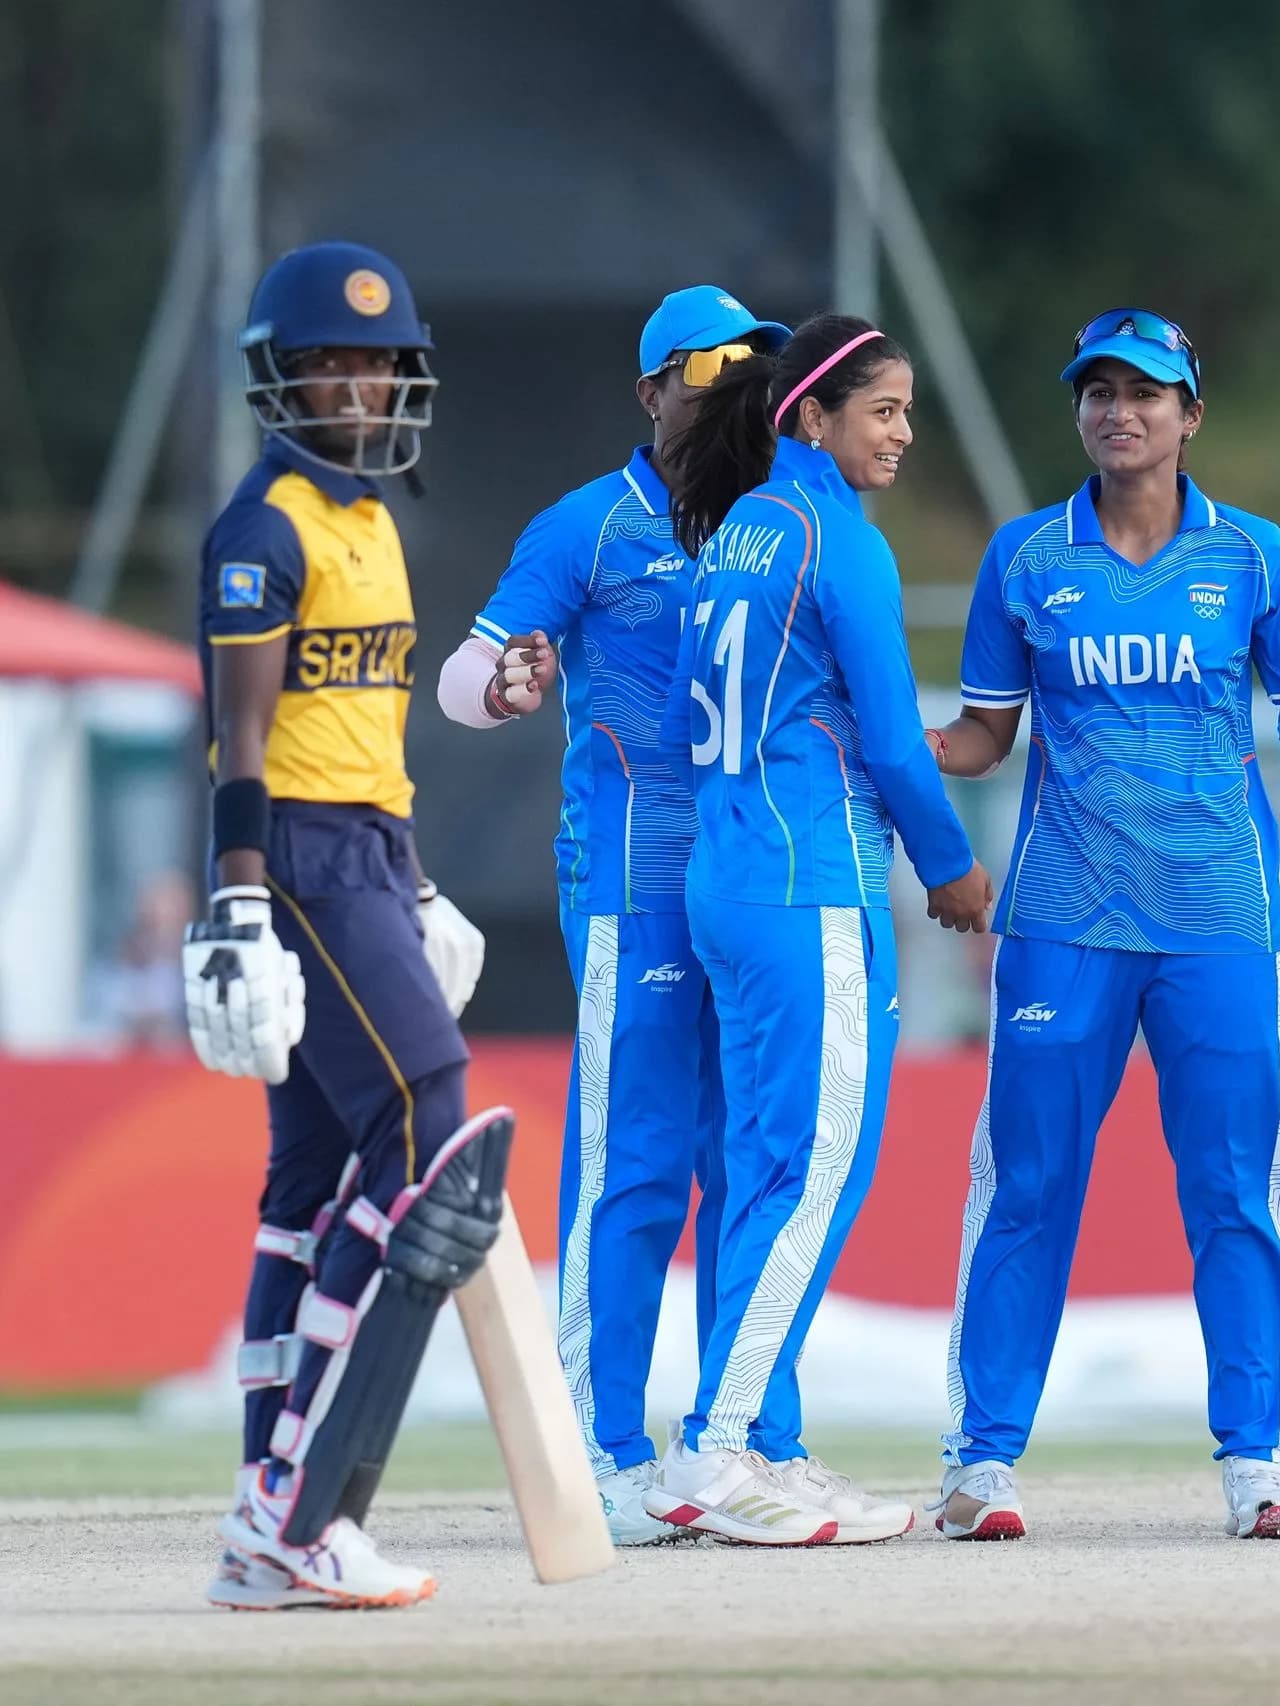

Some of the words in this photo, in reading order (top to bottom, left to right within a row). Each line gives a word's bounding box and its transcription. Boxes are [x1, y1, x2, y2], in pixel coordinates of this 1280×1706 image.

[642, 559, 685, 577] JSW
[1041, 591, 1086, 610] JSW
[1189, 591, 1226, 606] INDIA
[1069, 633, 1201, 687] INDIA
[636, 969, 686, 984] JSW
[1008, 1008, 1057, 1022] JSW
